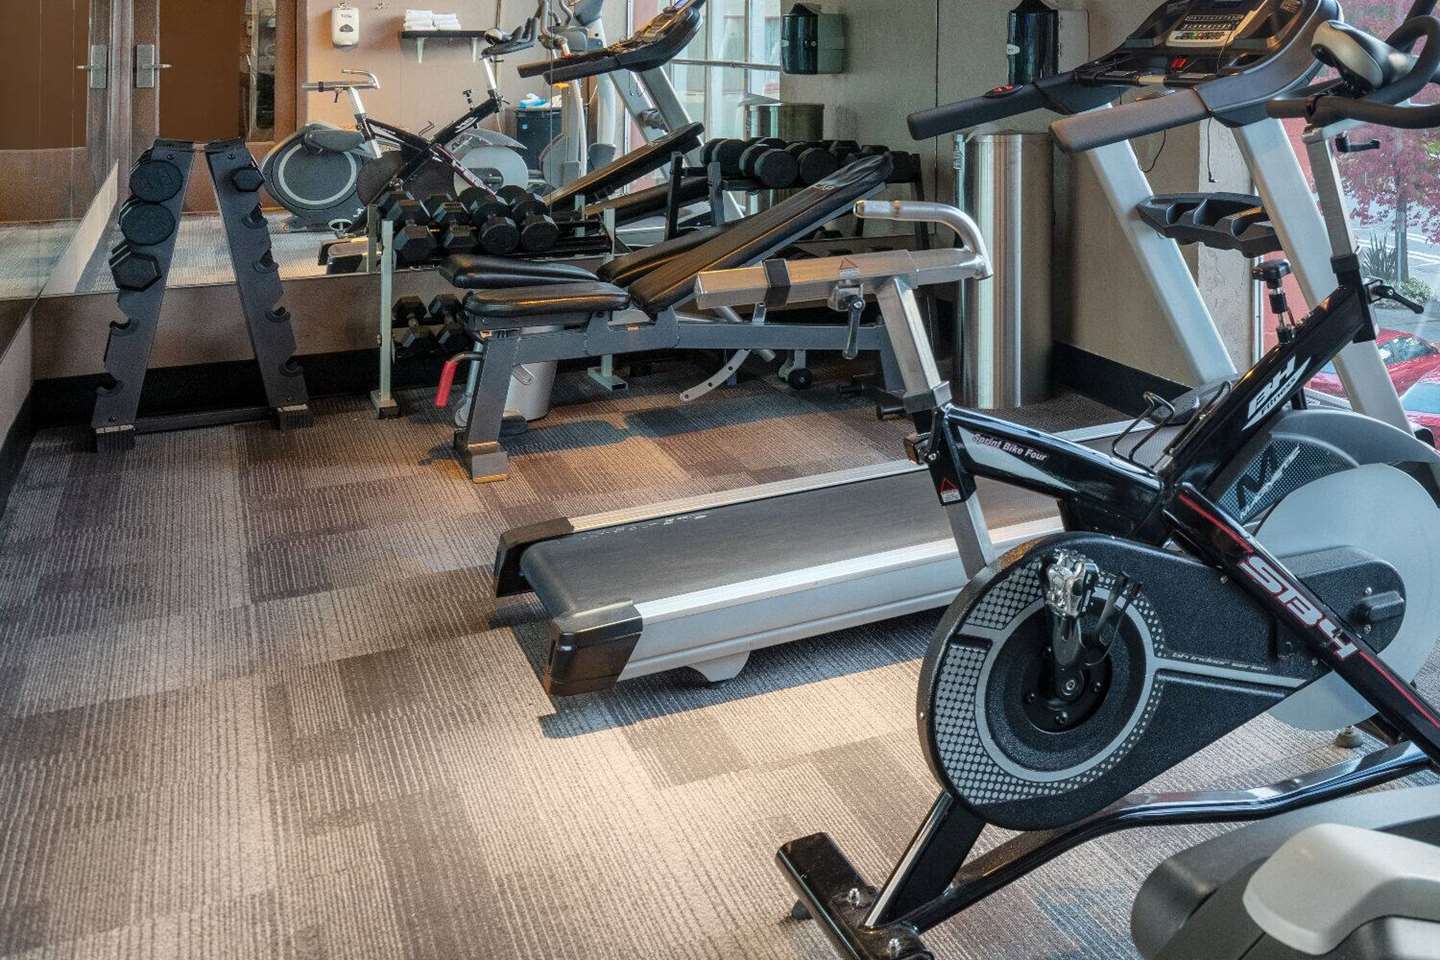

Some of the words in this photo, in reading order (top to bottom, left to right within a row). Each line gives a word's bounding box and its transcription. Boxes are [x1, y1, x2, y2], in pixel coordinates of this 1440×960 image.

[1248, 355, 1296, 420] BH
[974, 433, 1002, 448] Sprint
[1003, 442, 1024, 455] Bike
[1025, 449, 1047, 461] Four
